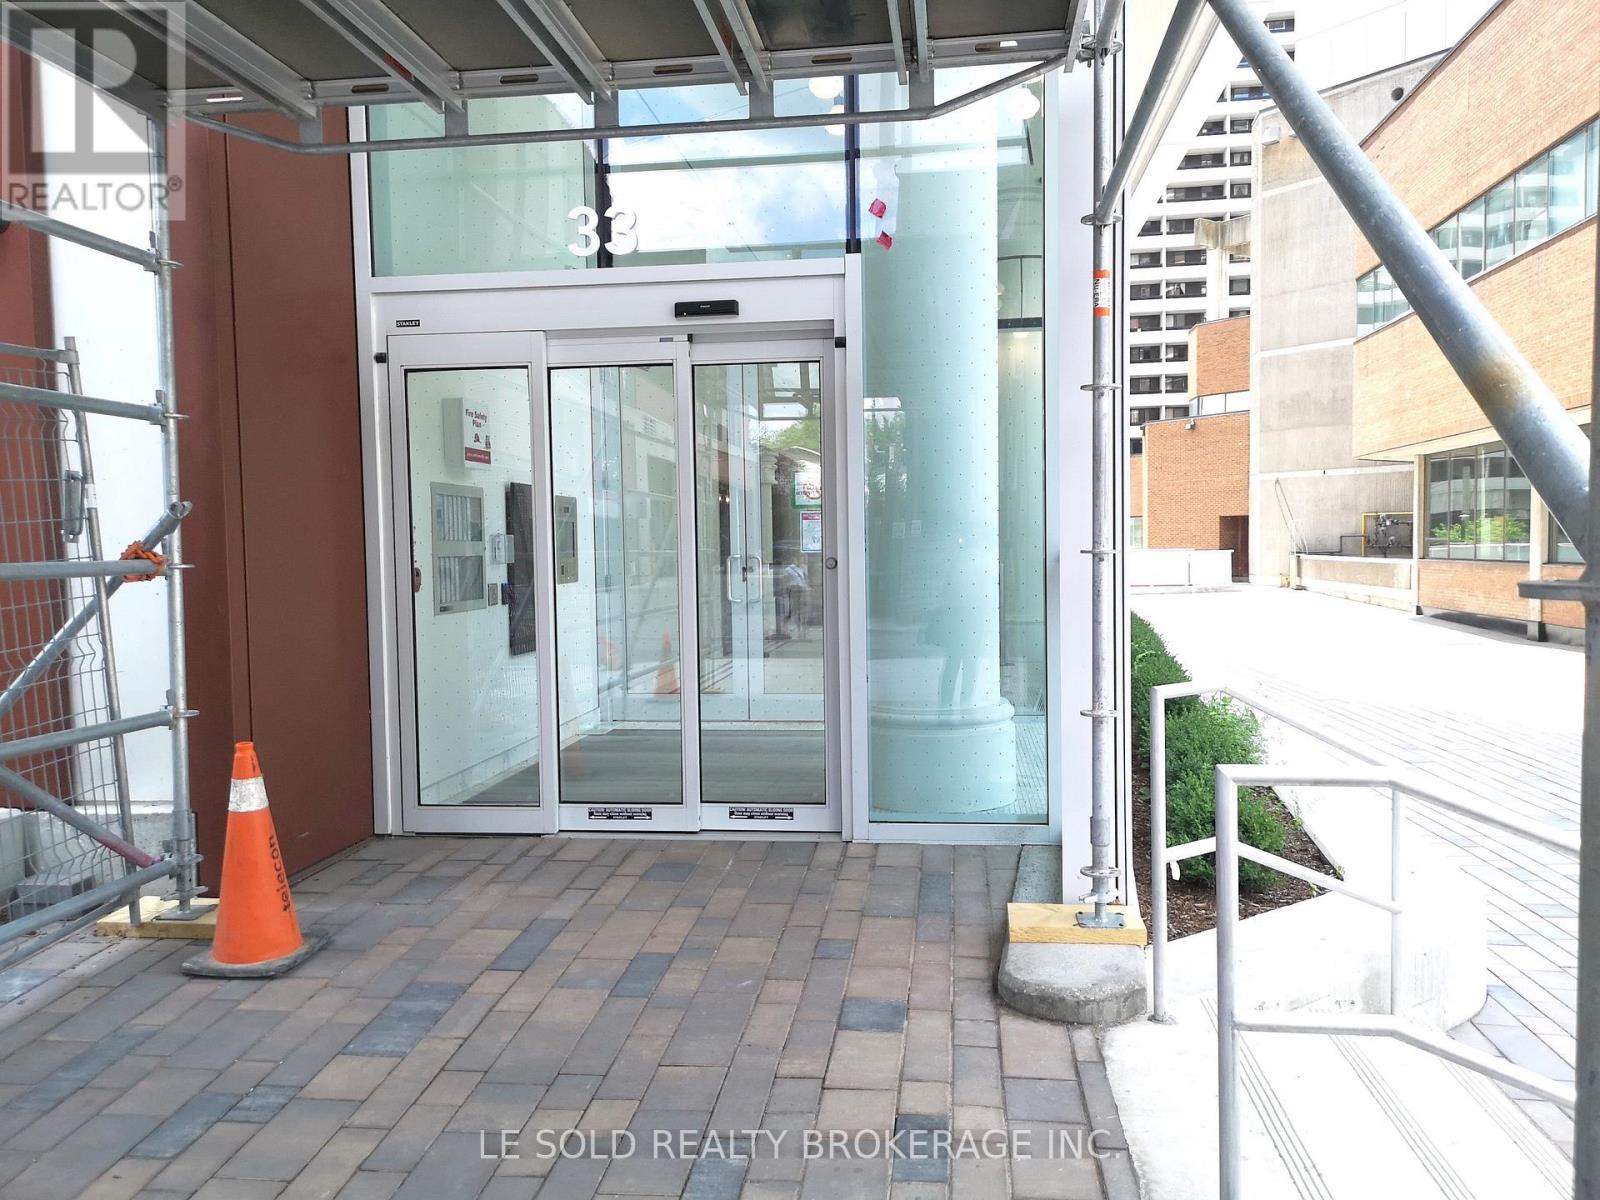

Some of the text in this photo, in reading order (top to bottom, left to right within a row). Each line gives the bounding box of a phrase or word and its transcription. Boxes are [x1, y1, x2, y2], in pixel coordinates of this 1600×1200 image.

[567, 206, 638, 257] 33
[465, 408, 488, 424] Fire Safety
[472, 419, 482, 428] Plan
